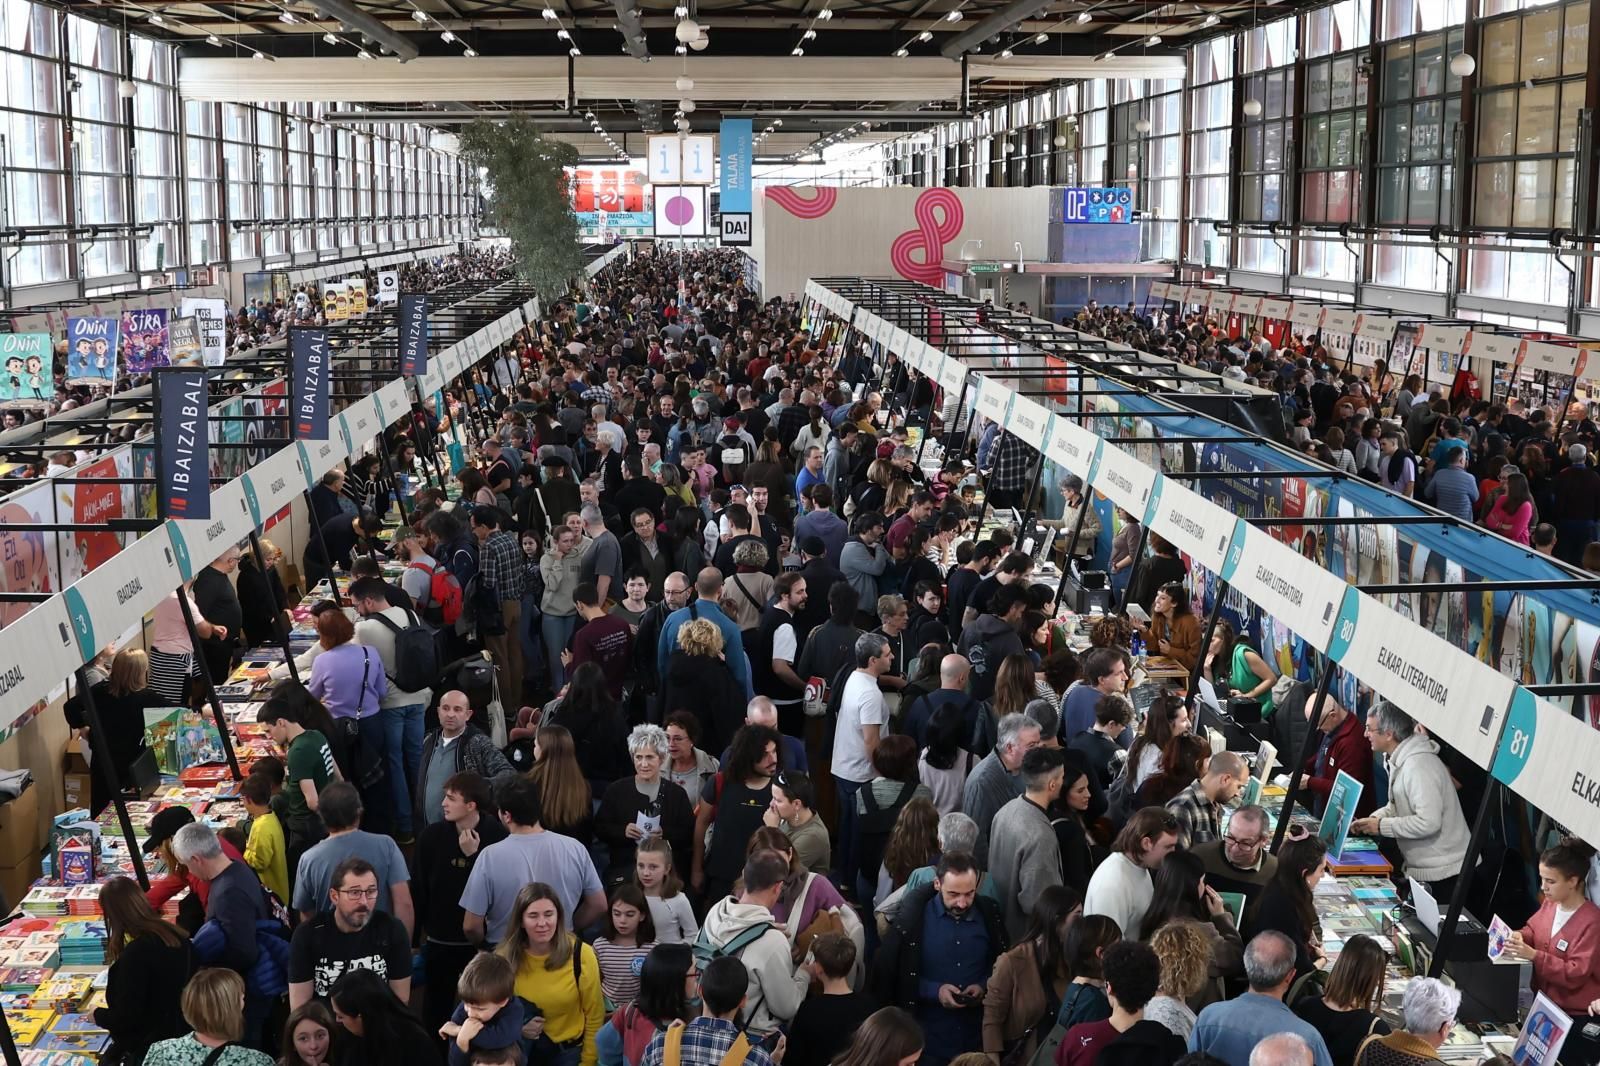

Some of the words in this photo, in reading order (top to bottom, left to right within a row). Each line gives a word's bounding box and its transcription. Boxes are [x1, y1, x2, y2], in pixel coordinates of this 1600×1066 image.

[727, 153, 738, 190] TALAIA
[1067, 190, 1087, 220] 02
[725, 221, 747, 234] DA!
[173, 336, 196, 346] NEGRA
[174, 328, 193, 338] ALMA
[407, 297, 426, 361] IBAIZABAL
[299, 332, 325, 420] IBAIZABAL
[172, 376, 204, 492] IBAIZABAL
[116, 577, 143, 605] IBAIZABAL
[1255, 565, 1273, 588] ELKAR
[1271, 574, 1304, 607] LITERATURA
[79, 614, 88, 634] 3
[1340, 618, 1353, 642] 80
[1377, 646, 1402, 676] ELKAR
[1400, 663, 1449, 707] LITERATURA
[1510, 728, 1529, 759] 81
